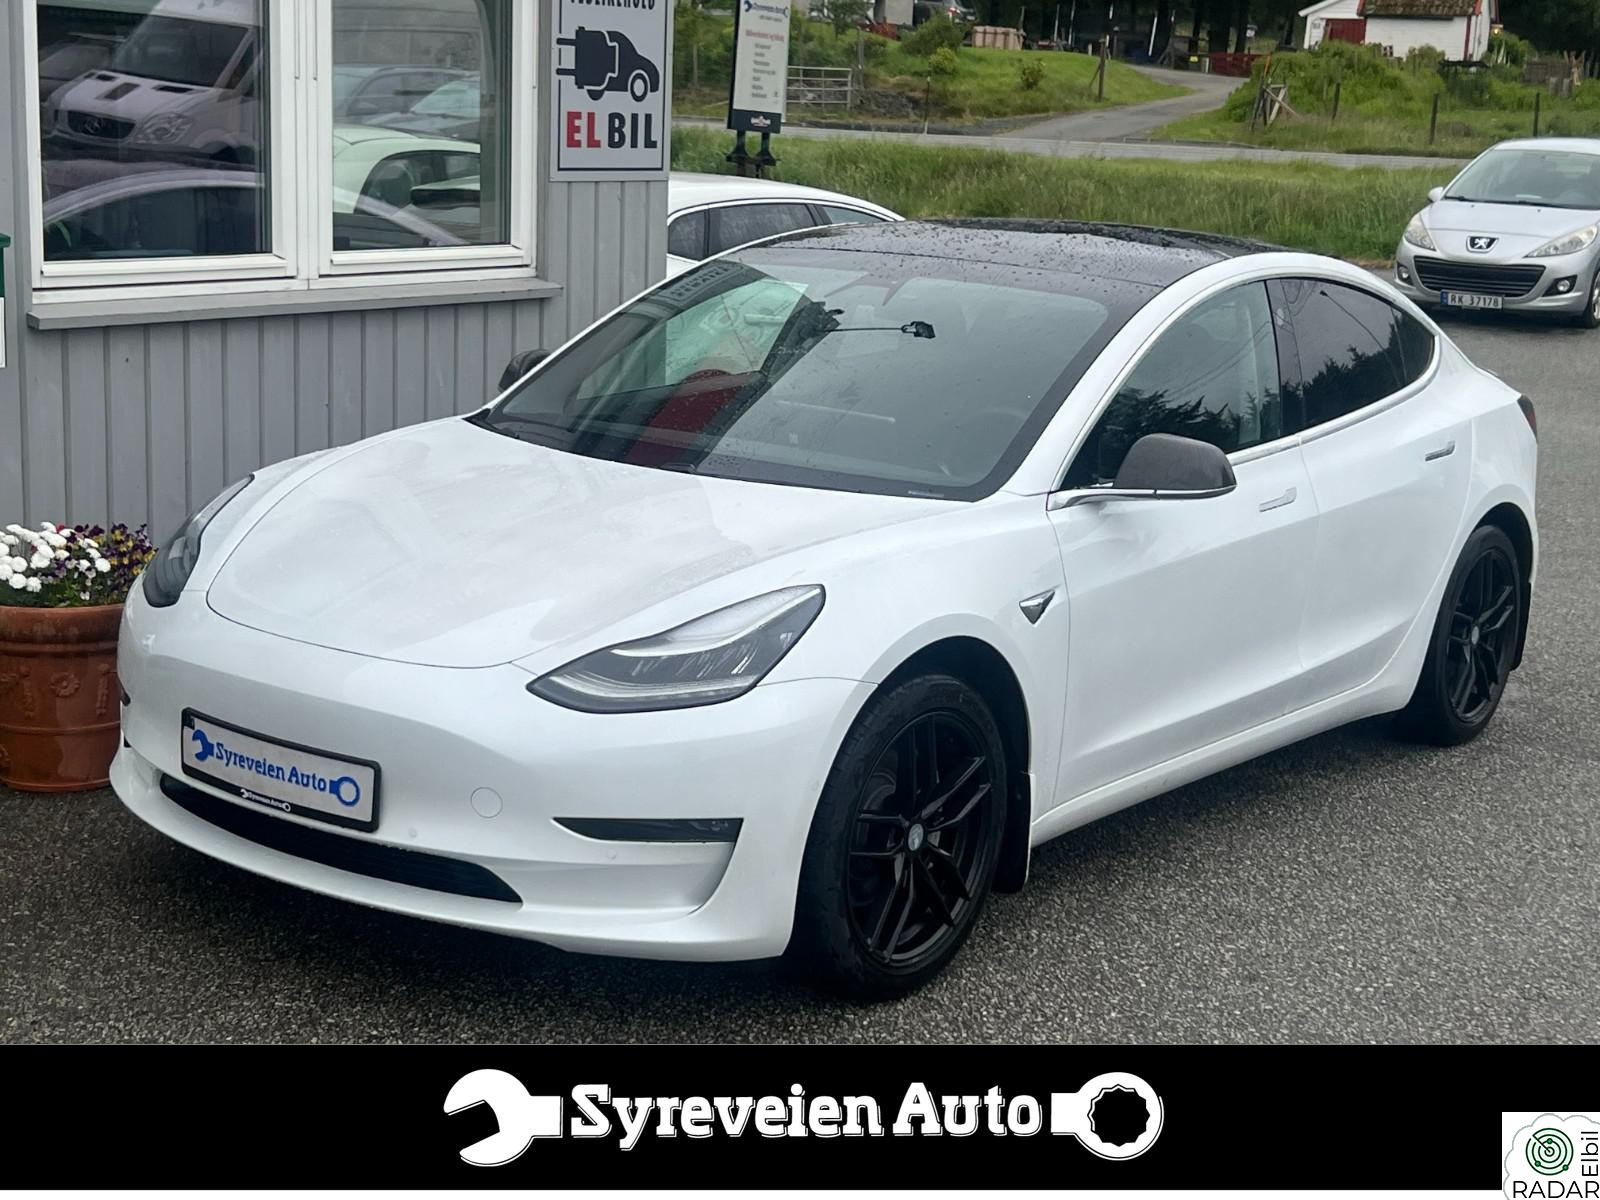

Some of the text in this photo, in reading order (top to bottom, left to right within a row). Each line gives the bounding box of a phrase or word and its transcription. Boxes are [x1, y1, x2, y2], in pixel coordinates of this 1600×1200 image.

[566, 111, 658, 149] ELBIL
[1450, 294, 1499, 308] RK 37178
[216, 742, 327, 791] Syreveien Auto
